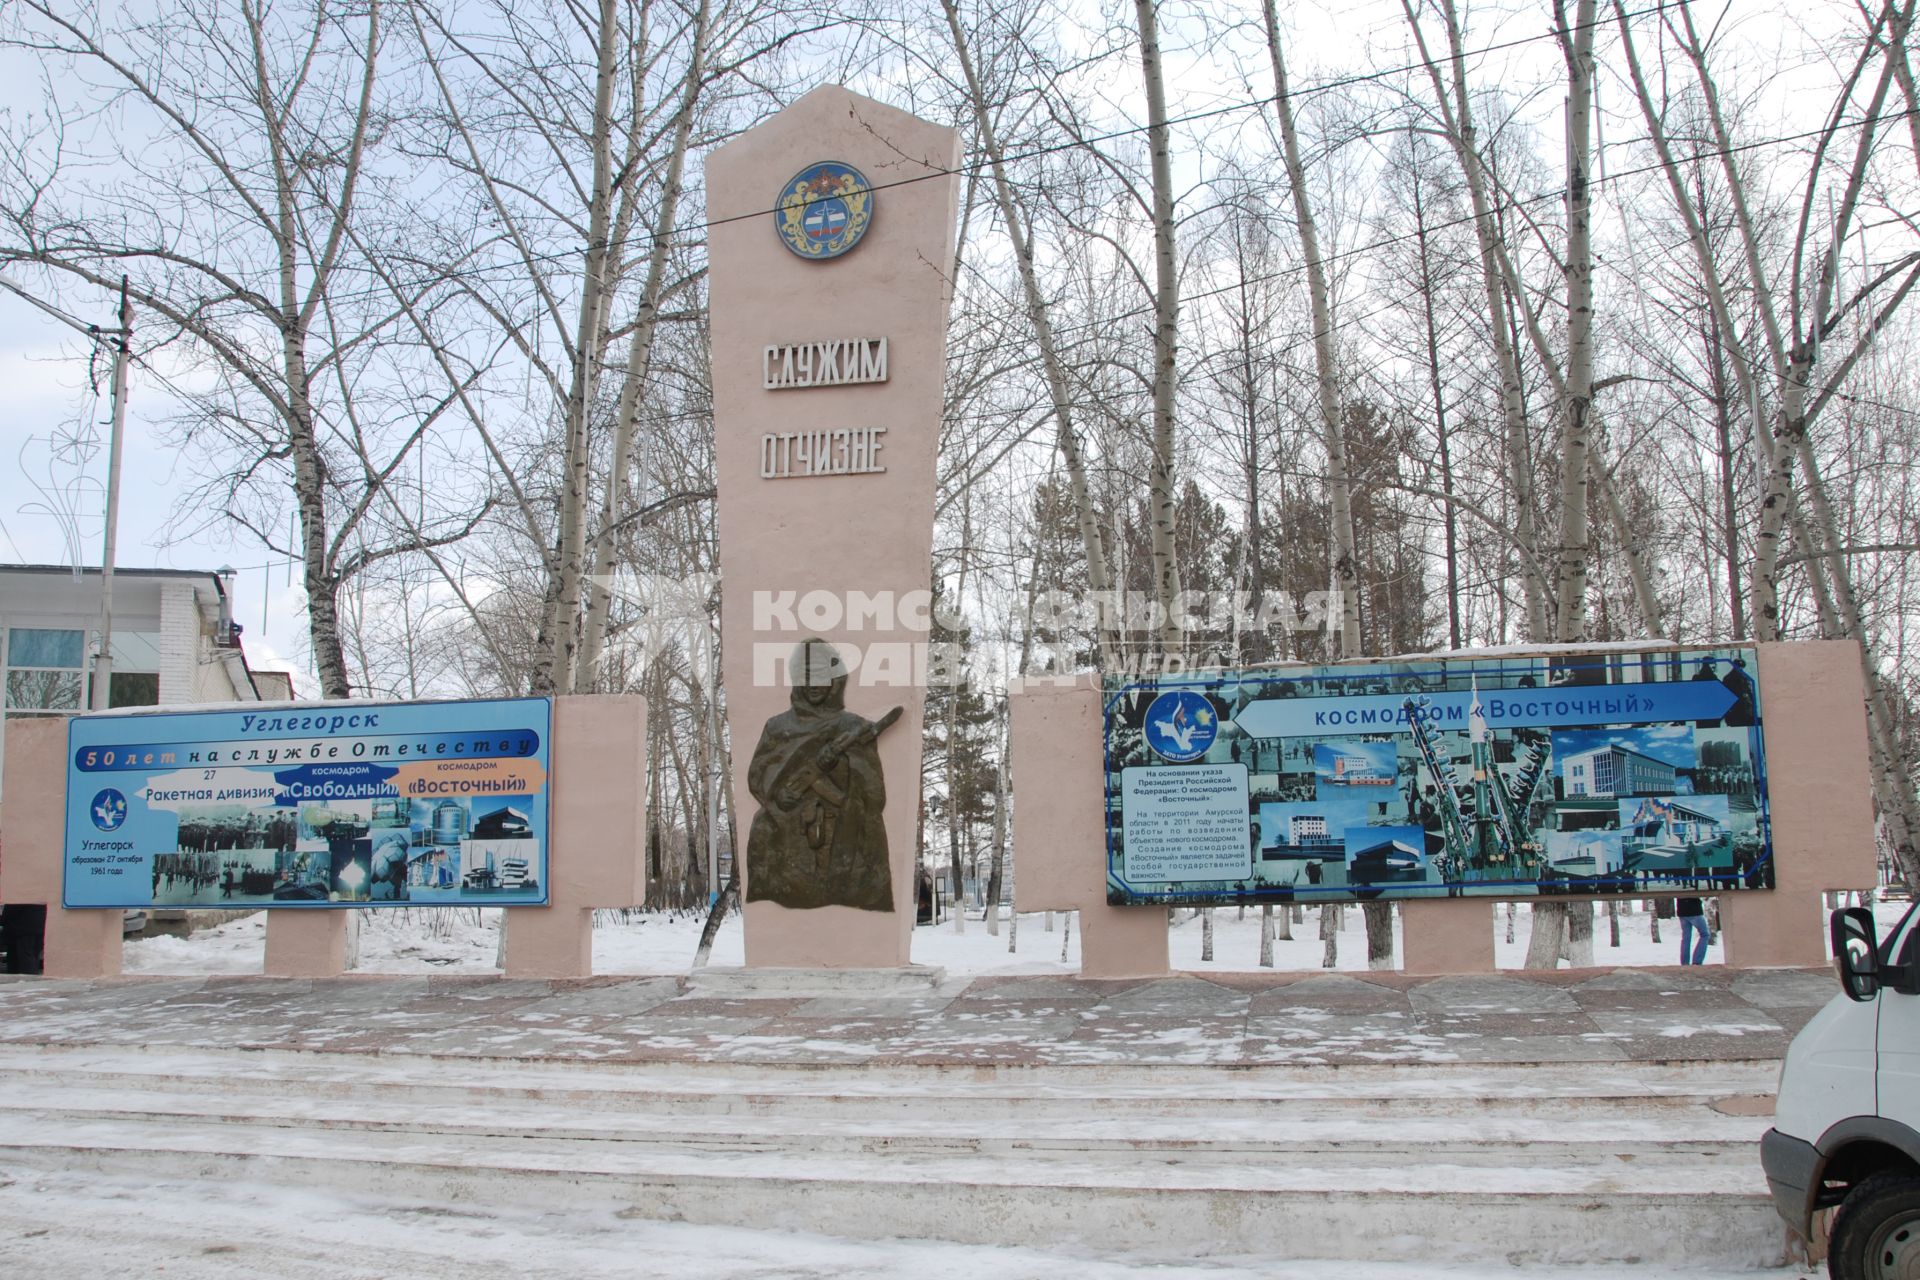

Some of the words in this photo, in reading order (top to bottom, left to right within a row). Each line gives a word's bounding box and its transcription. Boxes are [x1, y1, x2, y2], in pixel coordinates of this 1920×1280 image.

[764, 336, 888, 389] СЛУЖИМ
[761, 427, 887, 479] ОТЧИЗНЕ
[1315, 703, 1463, 726] космодром
[1474, 694, 1655, 719] «Восточный»
[241, 713, 379, 734] Углегорск
[86, 751, 116, 767] 50
[125, 752, 177, 766] лет
[189, 750, 219, 763] на
[232, 743, 338, 758] службе
[352, 739, 532, 757] Отечеству
[312, 765, 370, 777] космодром
[437, 760, 498, 772] космодром
[203, 769, 217, 781] 27
[408, 774, 526, 794] «Восточный»
[1138, 779, 1184, 787] Президента
[1186, 777, 1231, 785] Российской
[146, 788, 212, 801] Ракетная
[217, 786, 275, 801] дивизия
[1189, 786, 1237, 794] космодроме
[1154, 810, 1199, 818] территории
[1205, 808, 1243, 817] Амурской
[82, 840, 134, 852] Углегорск
